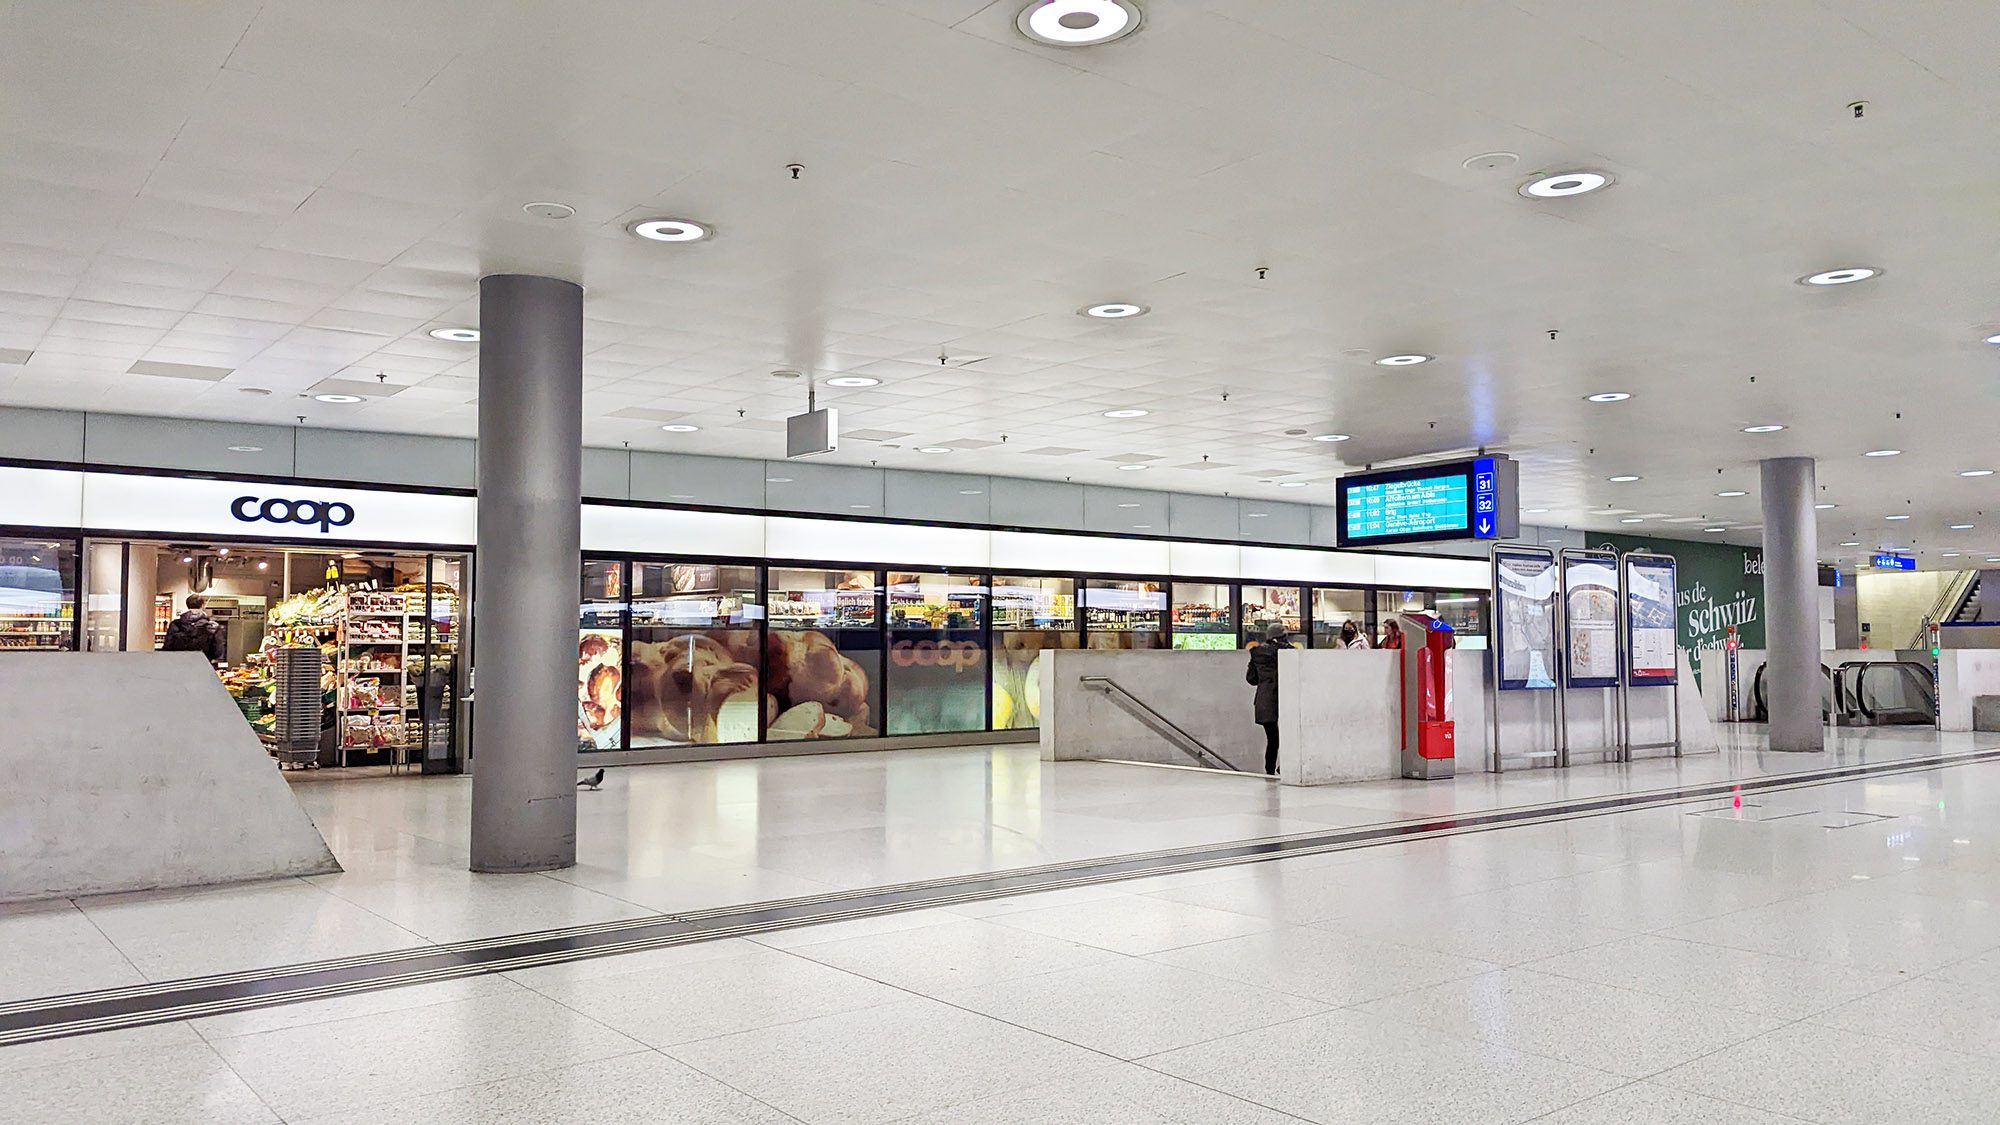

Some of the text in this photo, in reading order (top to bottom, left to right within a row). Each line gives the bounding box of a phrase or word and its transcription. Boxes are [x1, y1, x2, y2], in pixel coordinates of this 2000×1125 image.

[1479, 480, 1491, 489] 31
[231, 496, 354, 533] coop
[1479, 500, 1492, 510] 32
[1692, 581, 1706, 604] de
[1688, 590, 1757, 638] schwiiz
[891, 639, 981, 672] coop
